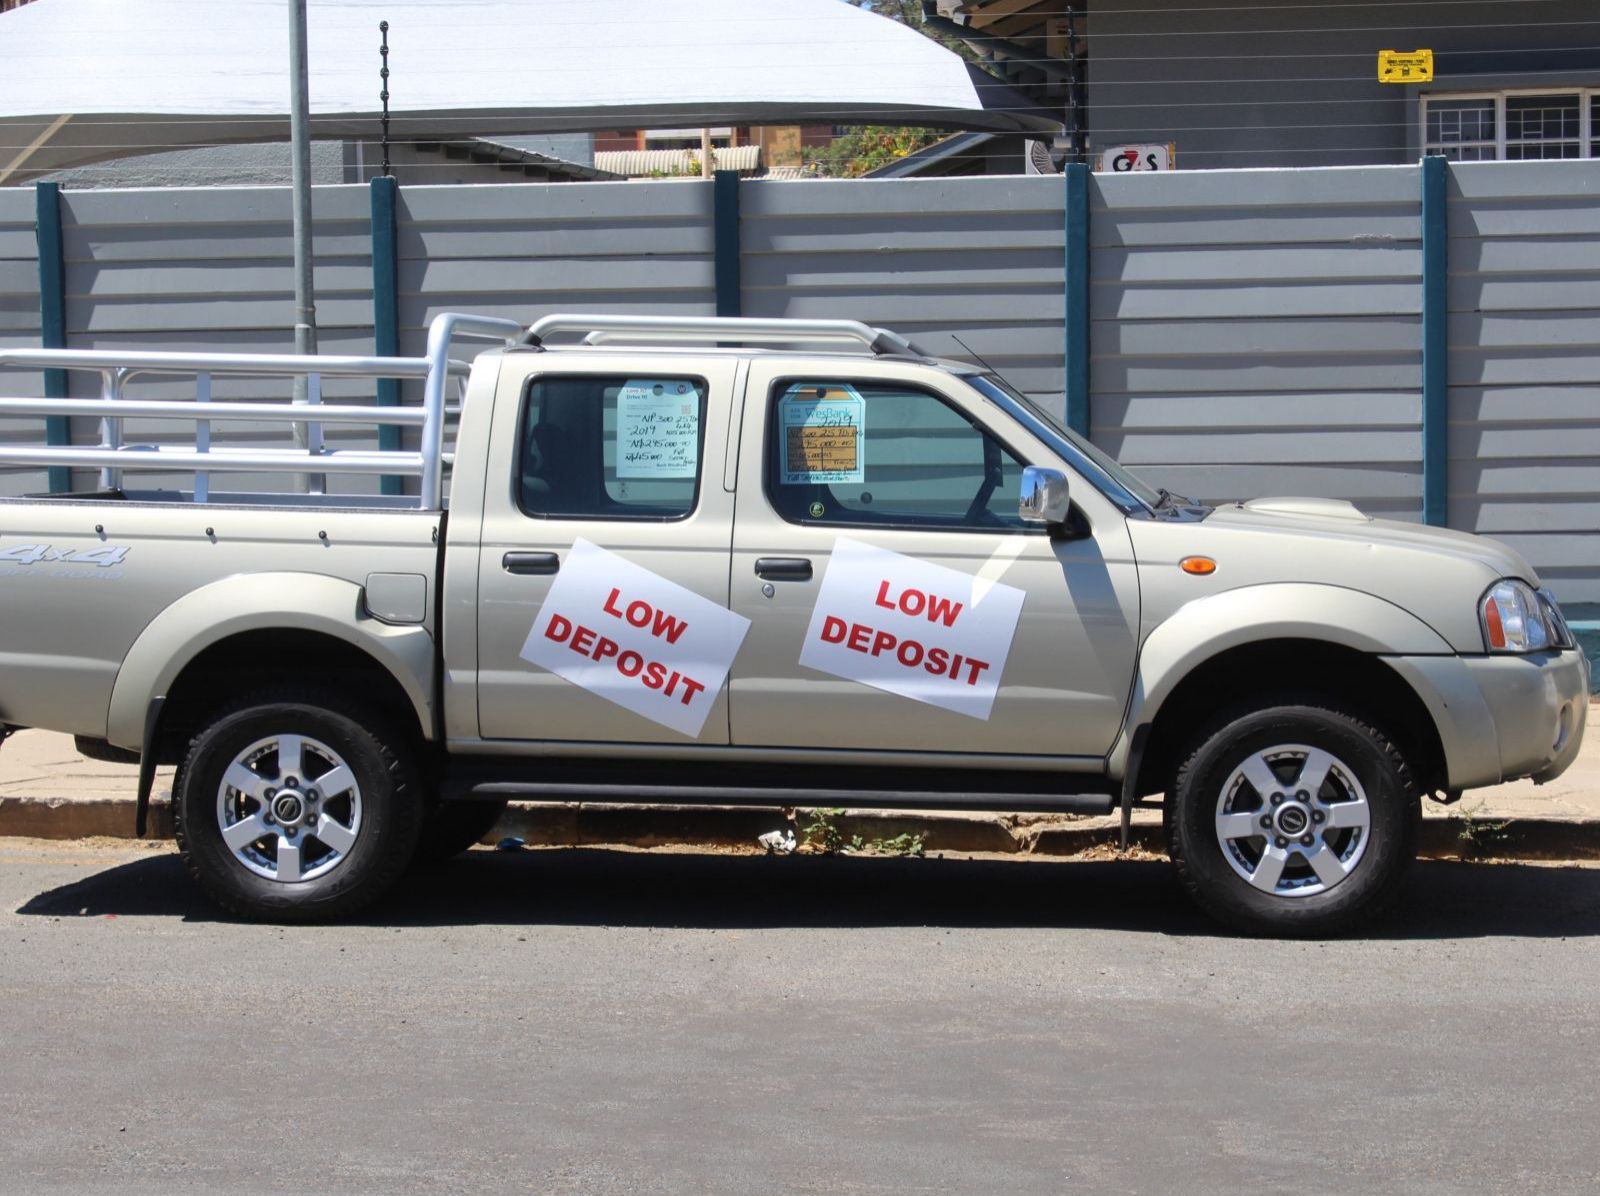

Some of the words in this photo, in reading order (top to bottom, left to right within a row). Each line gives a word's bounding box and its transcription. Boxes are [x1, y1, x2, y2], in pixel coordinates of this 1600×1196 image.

[630, 425, 656, 436] 2019
[0, 543, 131, 568] 4x4
[603, 588, 688, 645] LOW
[876, 580, 963, 627] LOW
[545, 613, 705, 705] DEPOSIT
[820, 615, 989, 686] DEPOSIT
